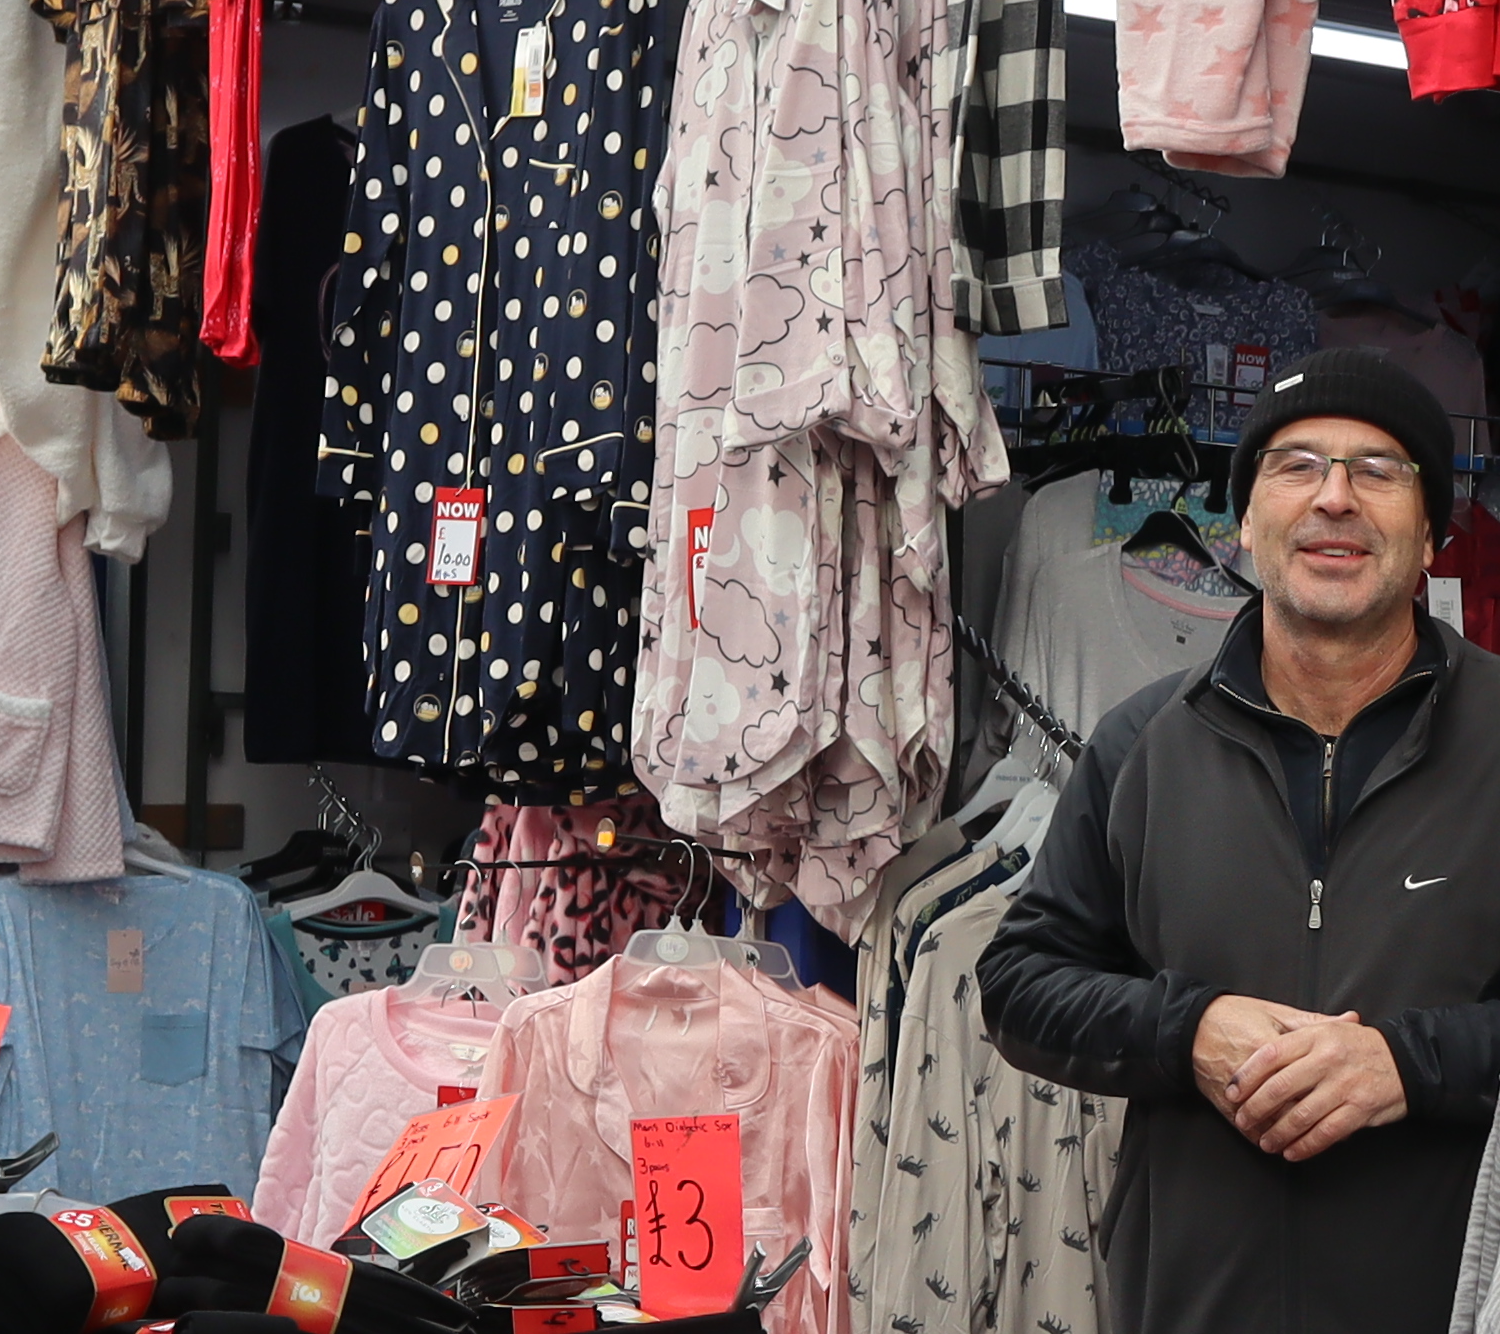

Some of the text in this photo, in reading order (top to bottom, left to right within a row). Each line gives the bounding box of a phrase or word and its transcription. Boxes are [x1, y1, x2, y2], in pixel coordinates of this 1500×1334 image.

[1236, 353, 1265, 366] NOW
[437, 502, 479, 518] NOW
[437, 527, 446, 541] £
[437, 543, 471, 566] 10.00
[695, 556, 705, 569] £
[330, 904, 376, 922] sale
[714, 1121, 732, 1132] Sox
[57, 1211, 95, 1227] £5
[645, 1180, 714, 1271] £3
